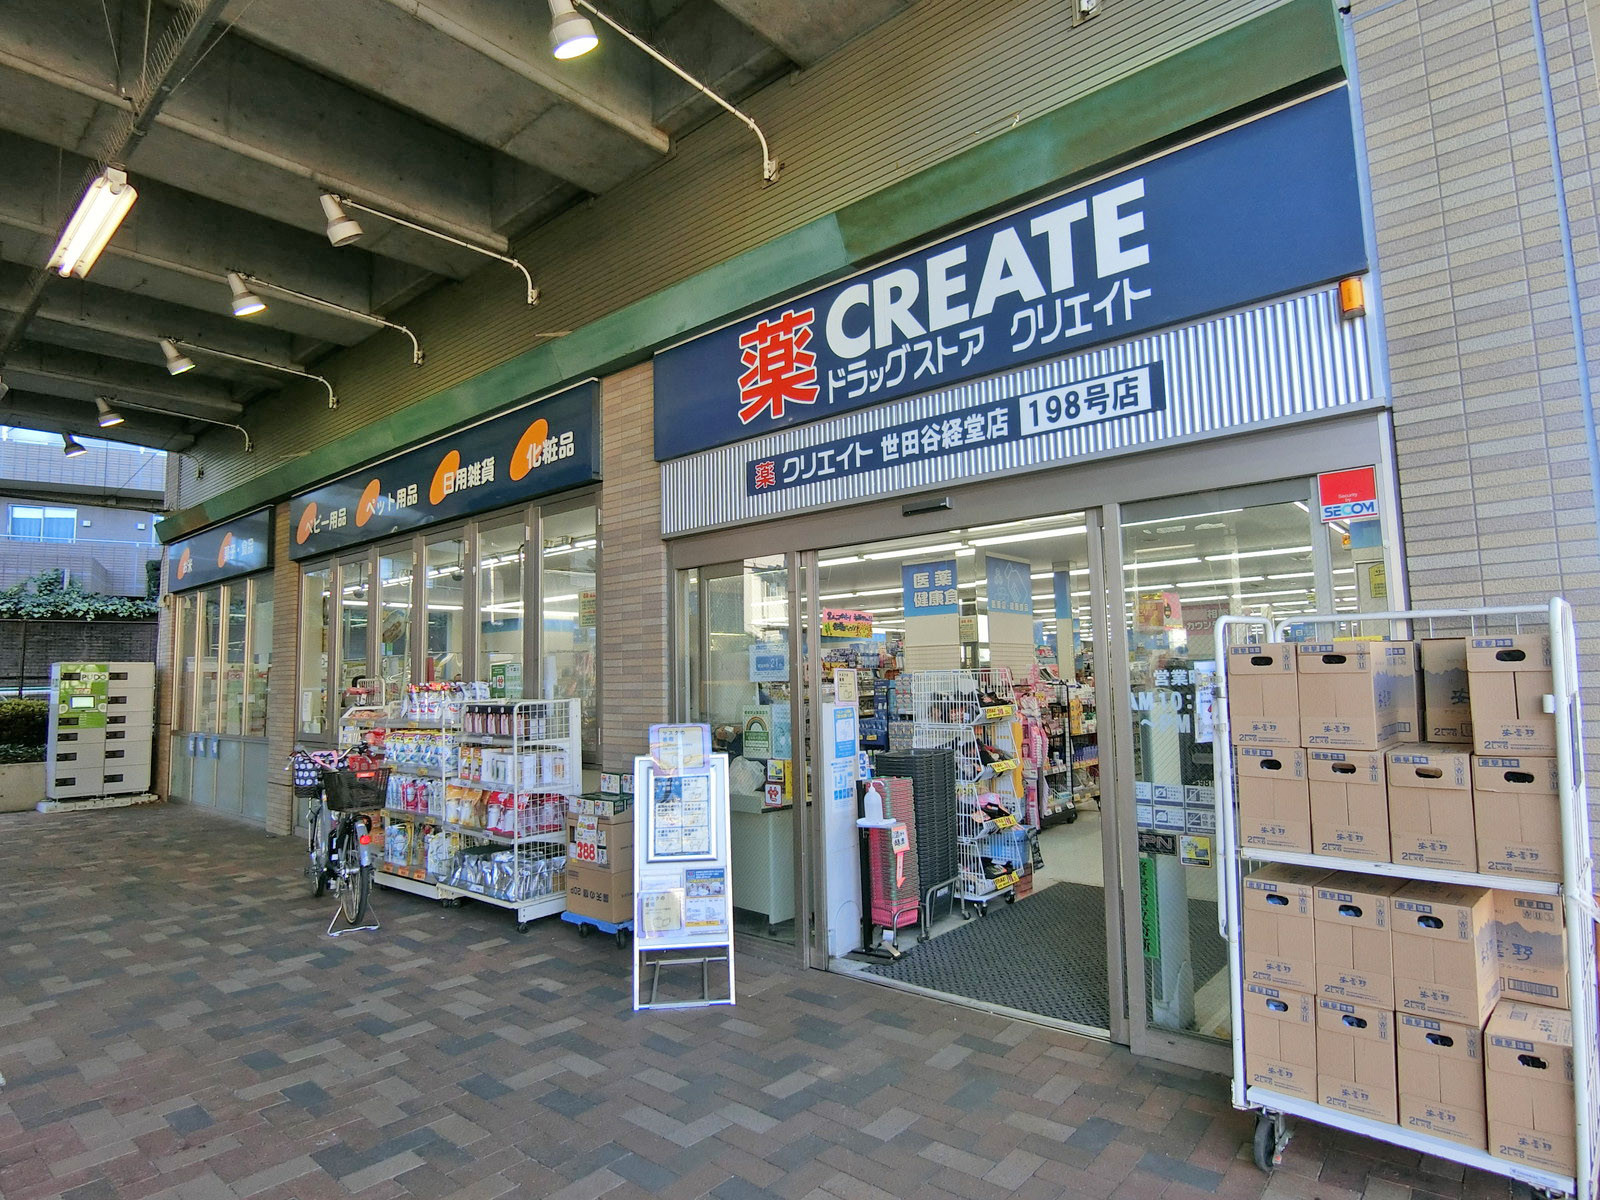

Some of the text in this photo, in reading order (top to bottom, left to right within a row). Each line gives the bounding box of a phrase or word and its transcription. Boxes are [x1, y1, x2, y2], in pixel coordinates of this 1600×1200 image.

[826, 178, 1151, 360] CREATE
[737, 308, 820, 425] 薬
[827, 278, 1152, 404] ドラッグストア クリエイト
[526, 431, 575, 469] 化粧品
[754, 375, 1140, 489] 薬 クリエイト 世田谷経堂店 198号店
[366, 484, 418, 516] ペット用品
[443, 456, 495, 496] 日用雑貨
[1324, 502, 1374, 518] SECOM
